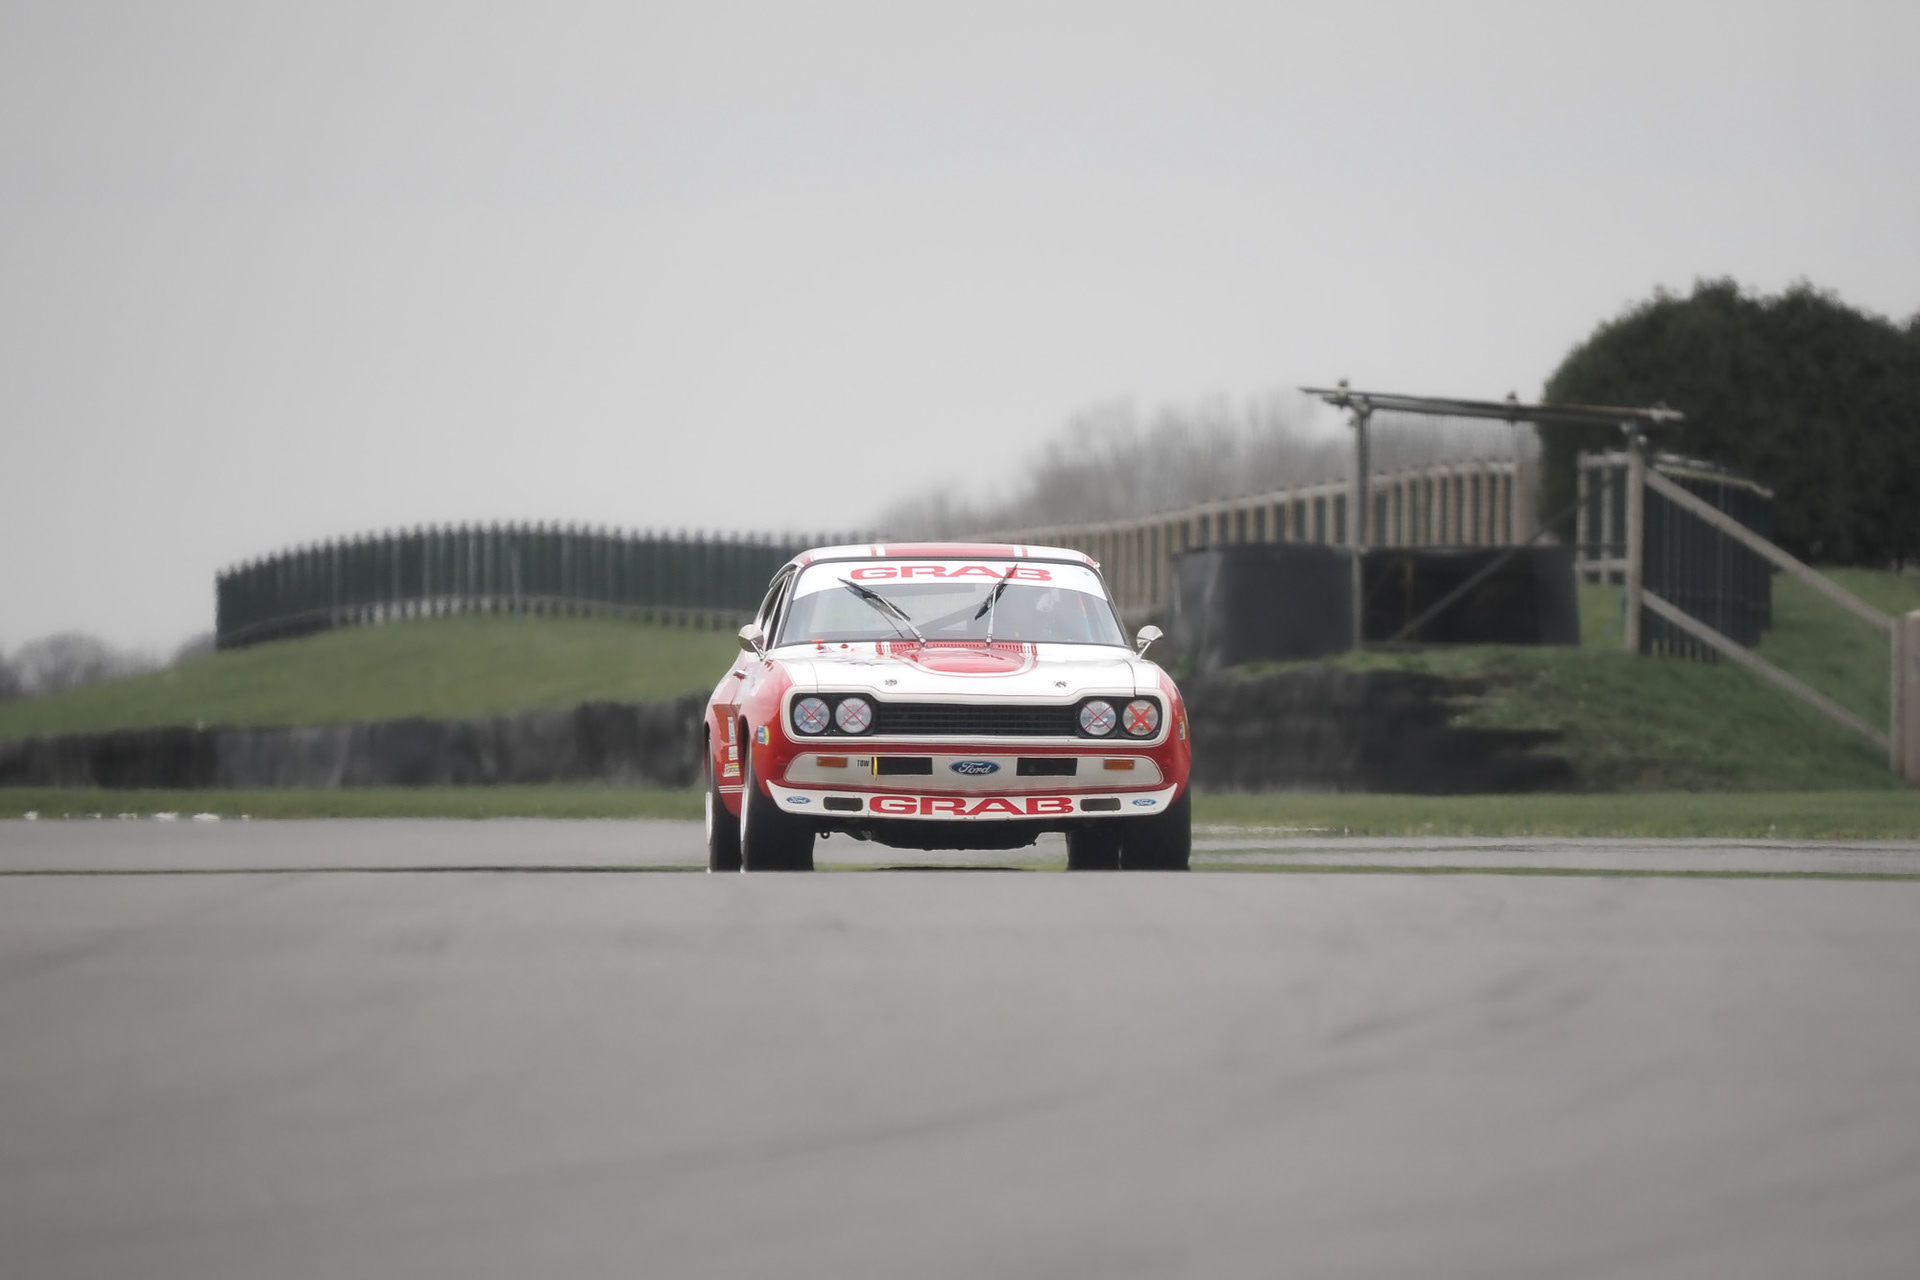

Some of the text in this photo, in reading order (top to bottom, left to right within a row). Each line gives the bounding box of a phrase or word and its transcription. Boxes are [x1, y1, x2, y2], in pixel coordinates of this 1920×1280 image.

[850, 566, 1053, 581] GRAB
[957, 761, 992, 774] Ford
[869, 796, 1074, 815] GRAB
